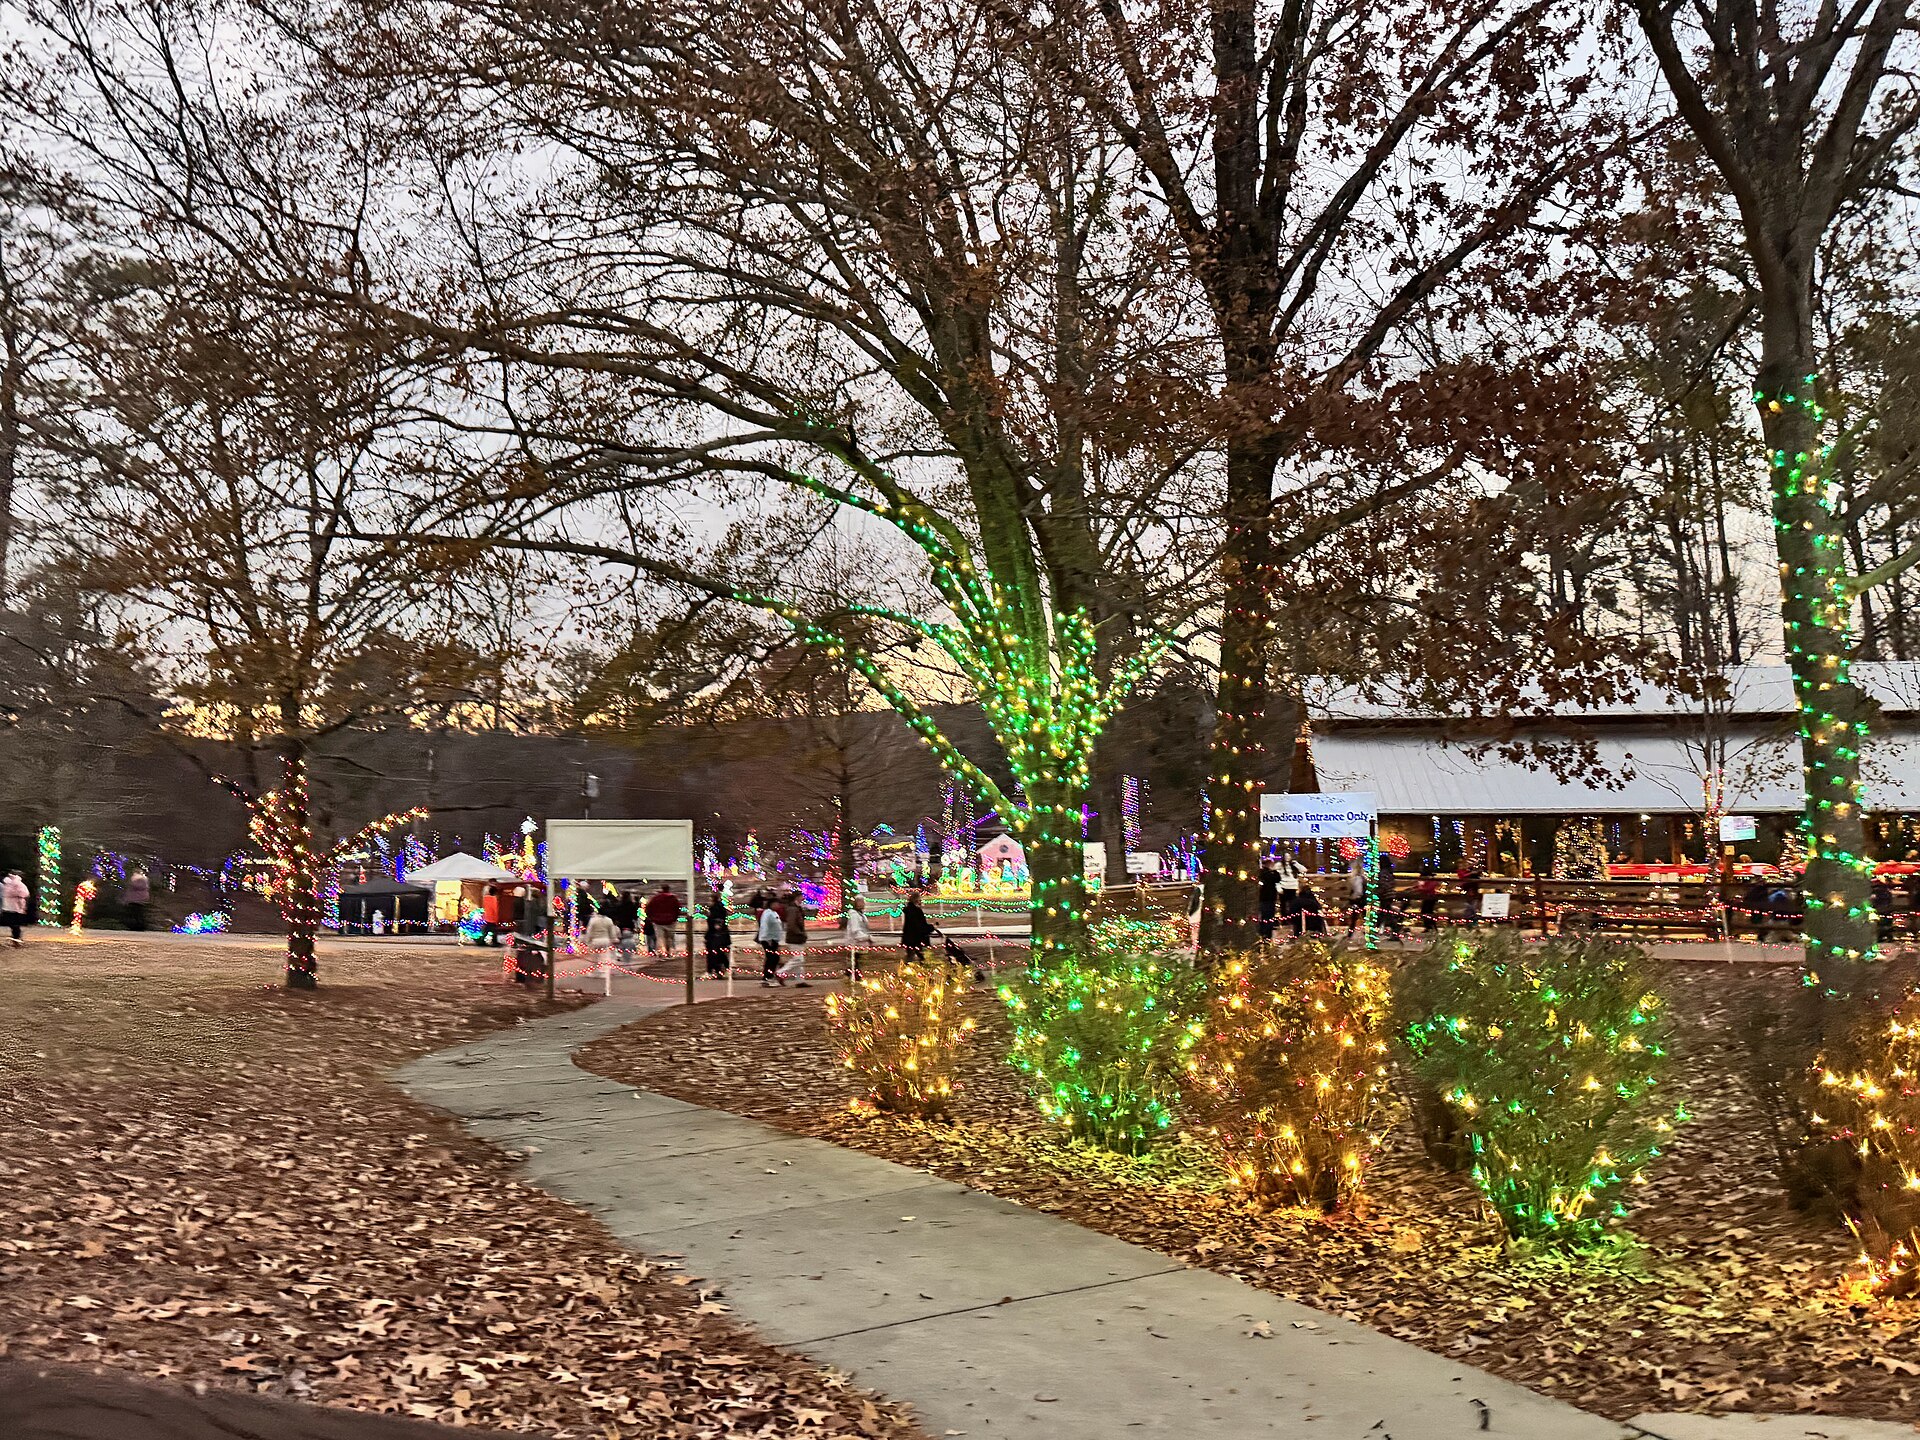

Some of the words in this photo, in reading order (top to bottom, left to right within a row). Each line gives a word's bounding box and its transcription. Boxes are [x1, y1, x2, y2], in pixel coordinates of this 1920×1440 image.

[1262, 812, 1303, 823] Handicap
[1305, 812, 1345, 822] Entrance
[1346, 811, 1369, 823] Only
